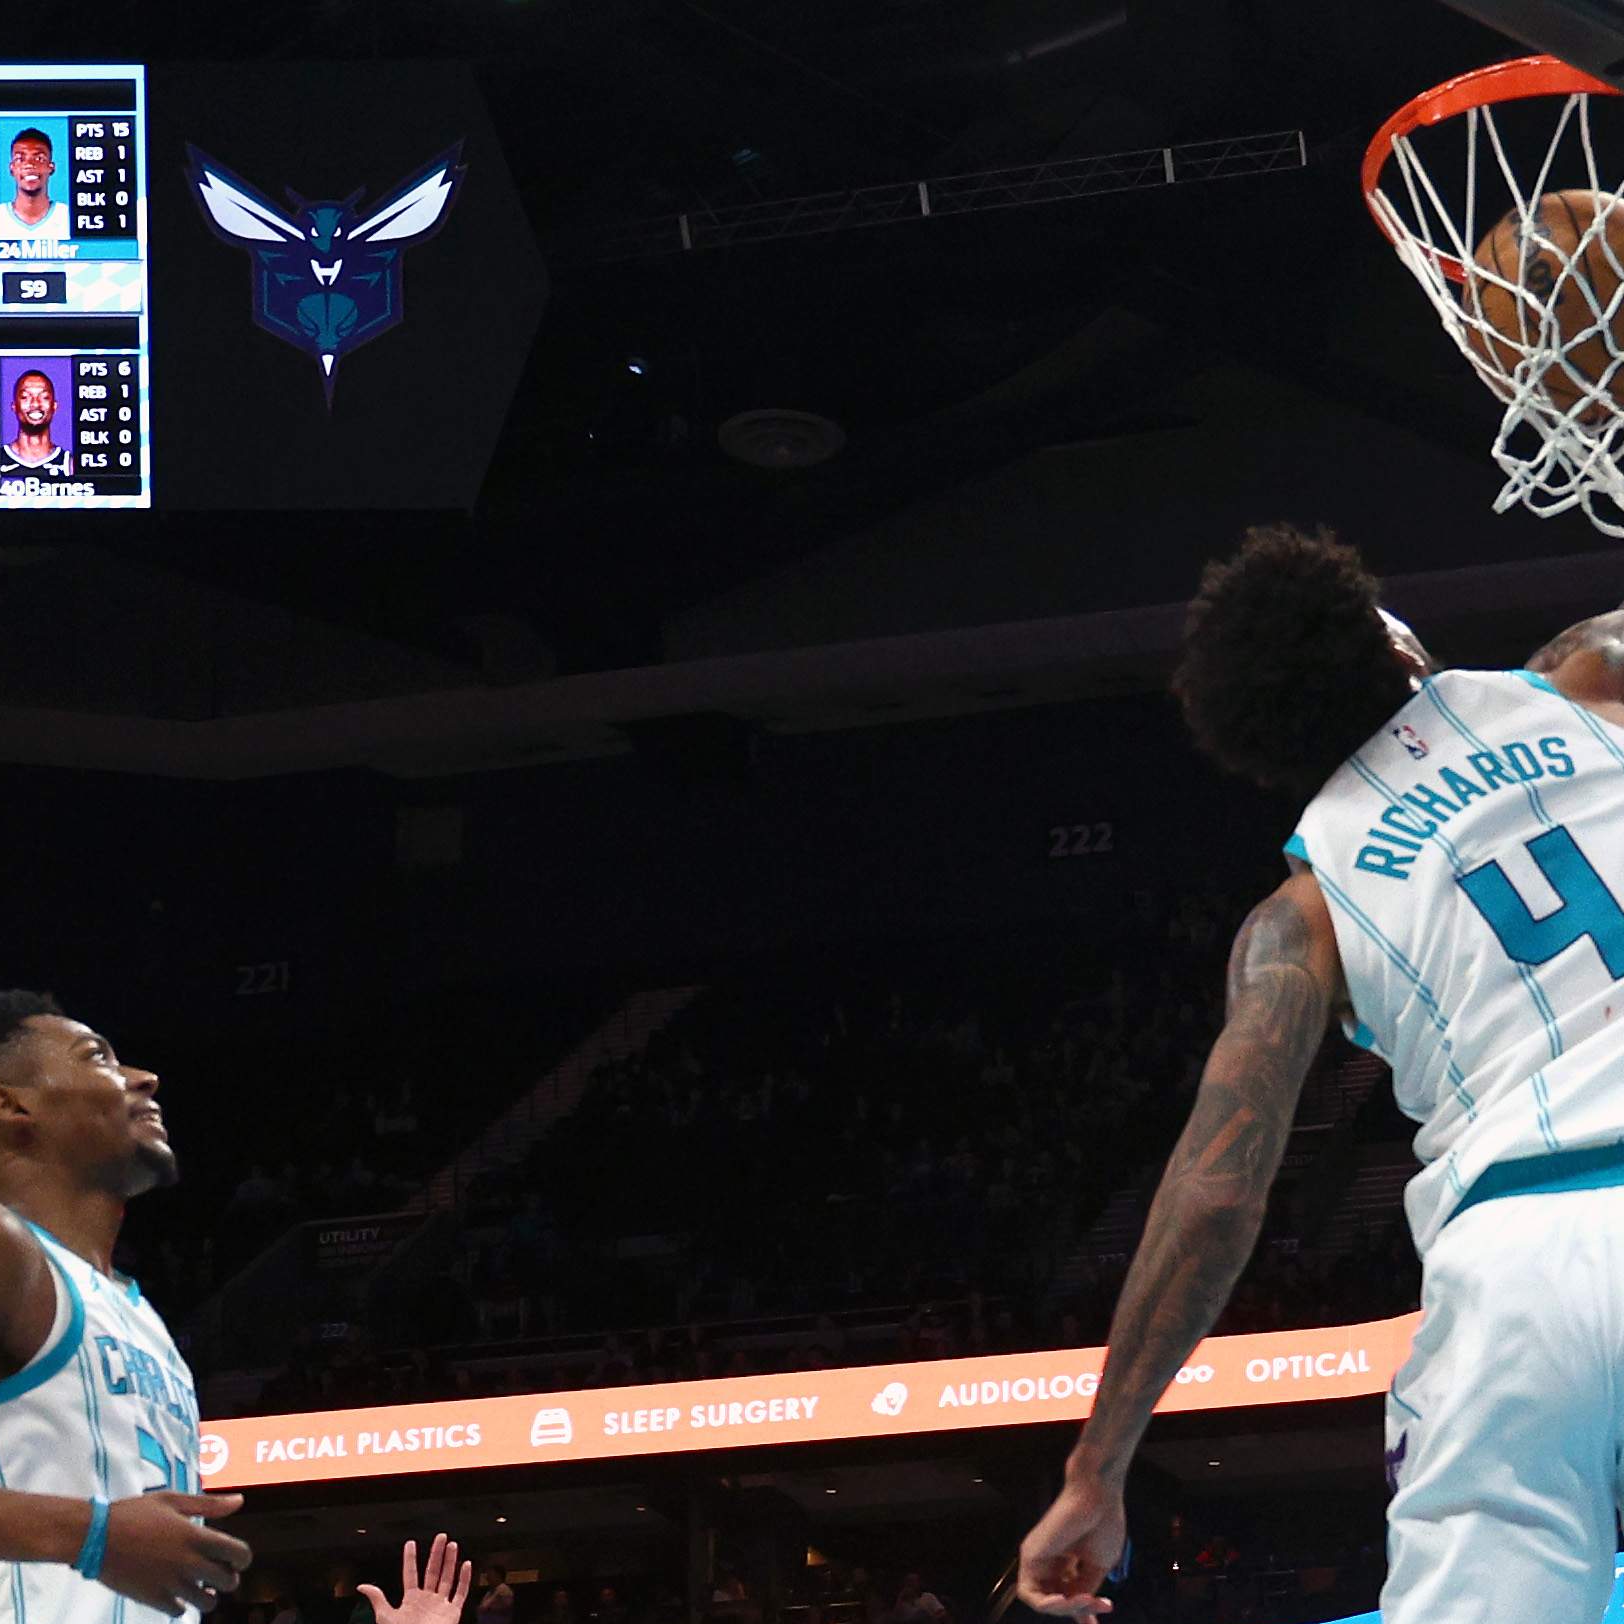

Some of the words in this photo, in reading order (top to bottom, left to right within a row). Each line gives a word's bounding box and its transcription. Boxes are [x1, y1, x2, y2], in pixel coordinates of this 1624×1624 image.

[21, 239, 79, 259] Miller
[20, 280, 47, 298] 59
[0, 481, 25, 497] 40
[25, 478, 95, 497] Barnes
[1355, 737, 1575, 880] RICHARDS
[1049, 822, 1114, 859] 222
[235, 960, 290, 996] 221
[256, 1434, 348, 1465] FACIAL
[358, 1423, 481, 1454] PLASTICS
[602, 1407, 681, 1436] SLEEP
[690, 1395, 819, 1429] SURGERY
[938, 1371, 1101, 1408] AUDIOLOG
[1245, 1348, 1371, 1384] OPTICAL
